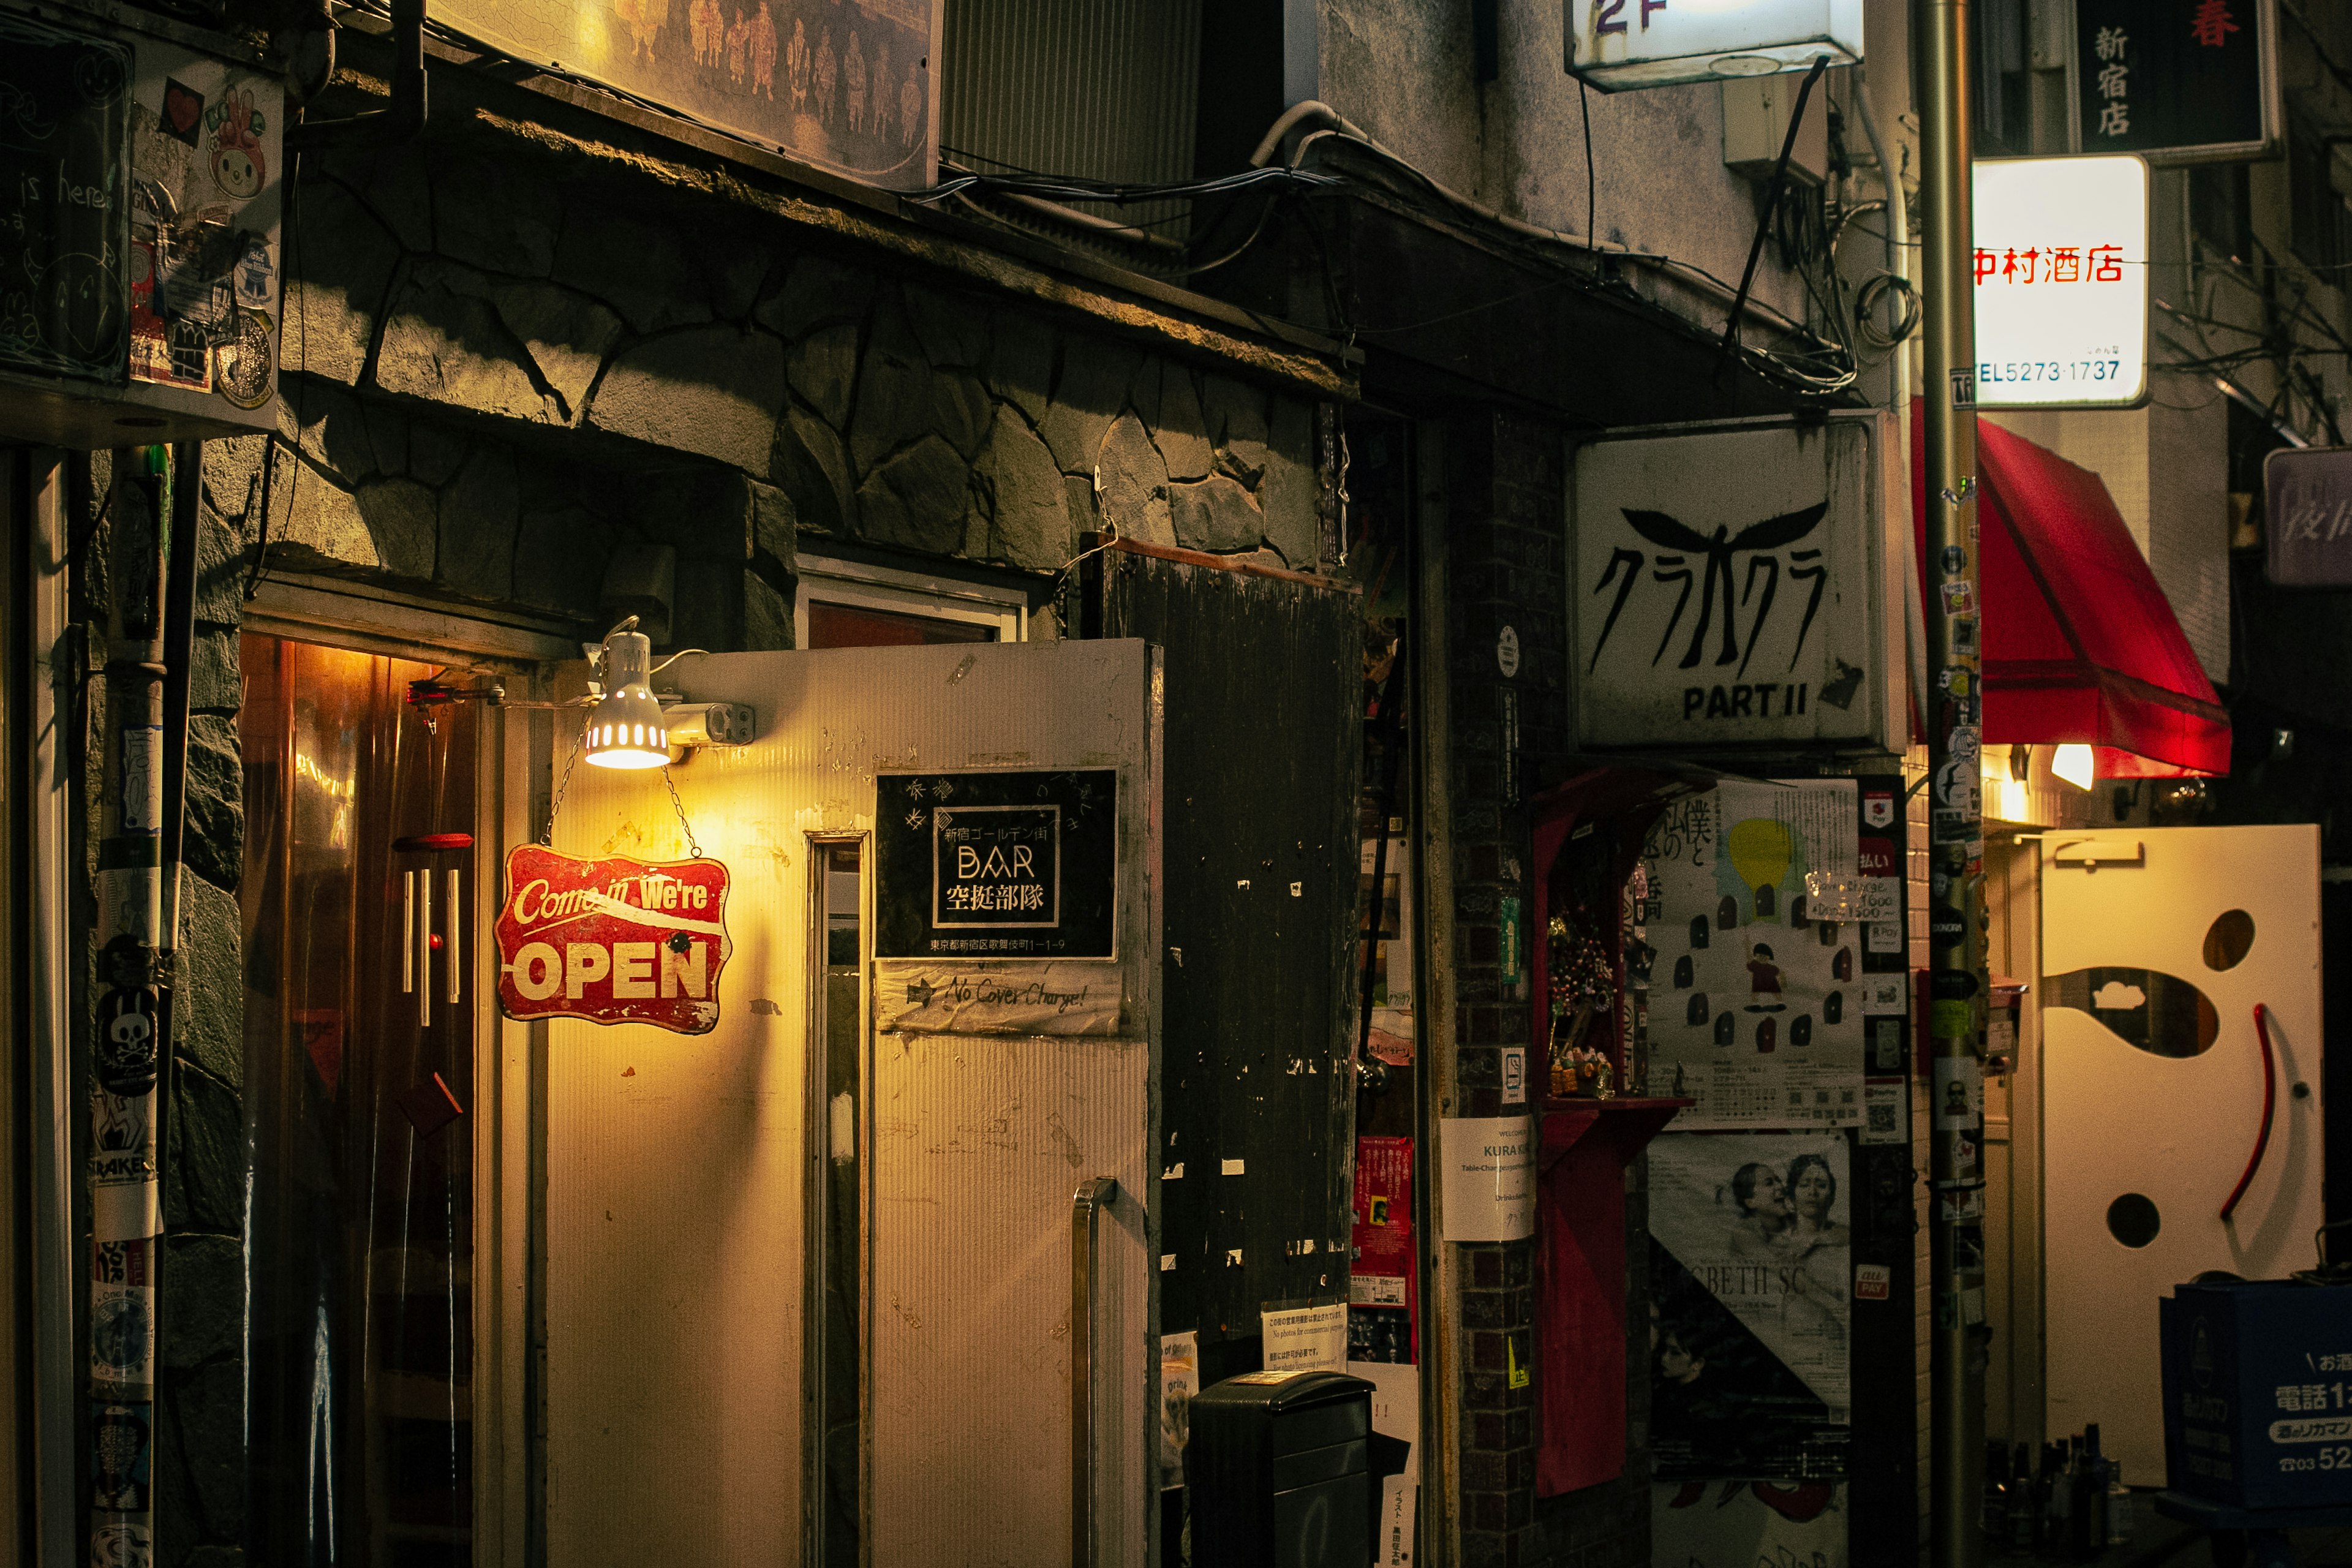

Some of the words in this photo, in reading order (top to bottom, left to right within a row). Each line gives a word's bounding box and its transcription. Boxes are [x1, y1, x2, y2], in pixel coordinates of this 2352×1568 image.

[2191, 0, 2241, 47] 春
[2095, 26, 2130, 137] 新宿店
[241, 257, 254, 269] Blue
[253, 262, 273, 276] Ribbon
[248, 251, 265, 262] Pabst
[1976, 360, 2119, 383] EL5273·1737
[1684, 684, 1780, 720] PART
[944, 827, 1047, 843] 新宿ゴールデン街
[1685, 799, 1711, 866] 僕と
[958, 845, 1035, 879] BAR
[513, 878, 600, 925] Come
[640, 879, 707, 910] We're
[946, 884, 1044, 911] 空挺部隊
[512, 941, 707, 1001] OPEN
[944, 976, 971, 1003] No
[976, 978, 1018, 1005] Cover
[1861, 1270, 1882, 1281] au
[1861, 1283, 1882, 1293] PAY
[1273, 1330, 1280, 1338] No
[1280, 1329, 1296, 1340] photos
[1167, 1381, 1188, 1393] Drink
[2275, 1382, 2352, 1412] 電話1
